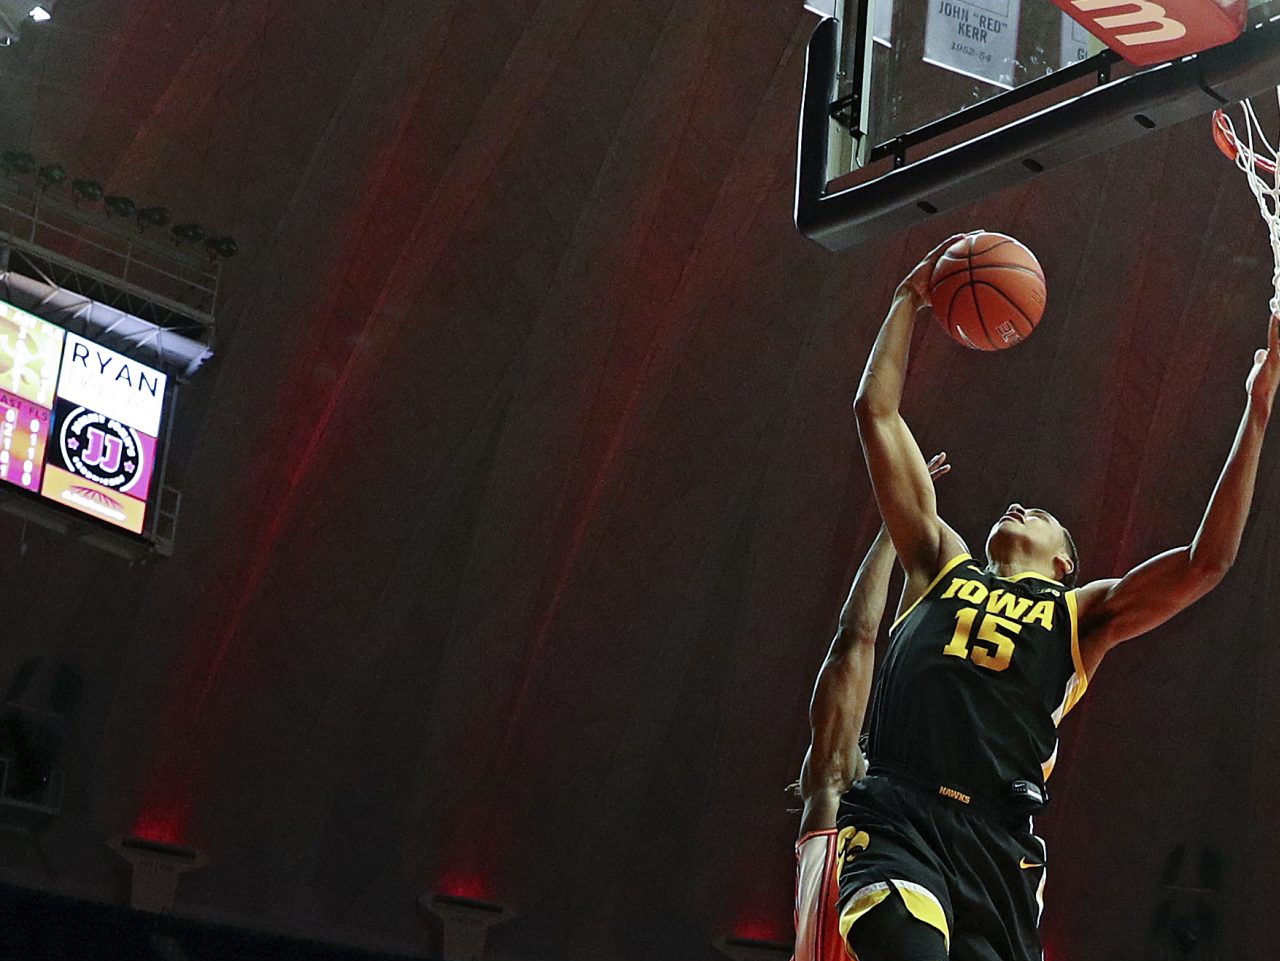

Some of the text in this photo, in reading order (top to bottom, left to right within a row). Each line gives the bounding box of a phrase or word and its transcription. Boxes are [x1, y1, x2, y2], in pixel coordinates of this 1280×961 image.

[938, 0, 1008, 34] JOHN "RED"
[957, 21, 988, 43] KERR
[71, 341, 158, 397] RYAN
[82, 426, 122, 473] JJ
[940, 578, 1055, 632] IOWA
[943, 607, 1022, 672] 15
[939, 785, 971, 805] HAWKS
